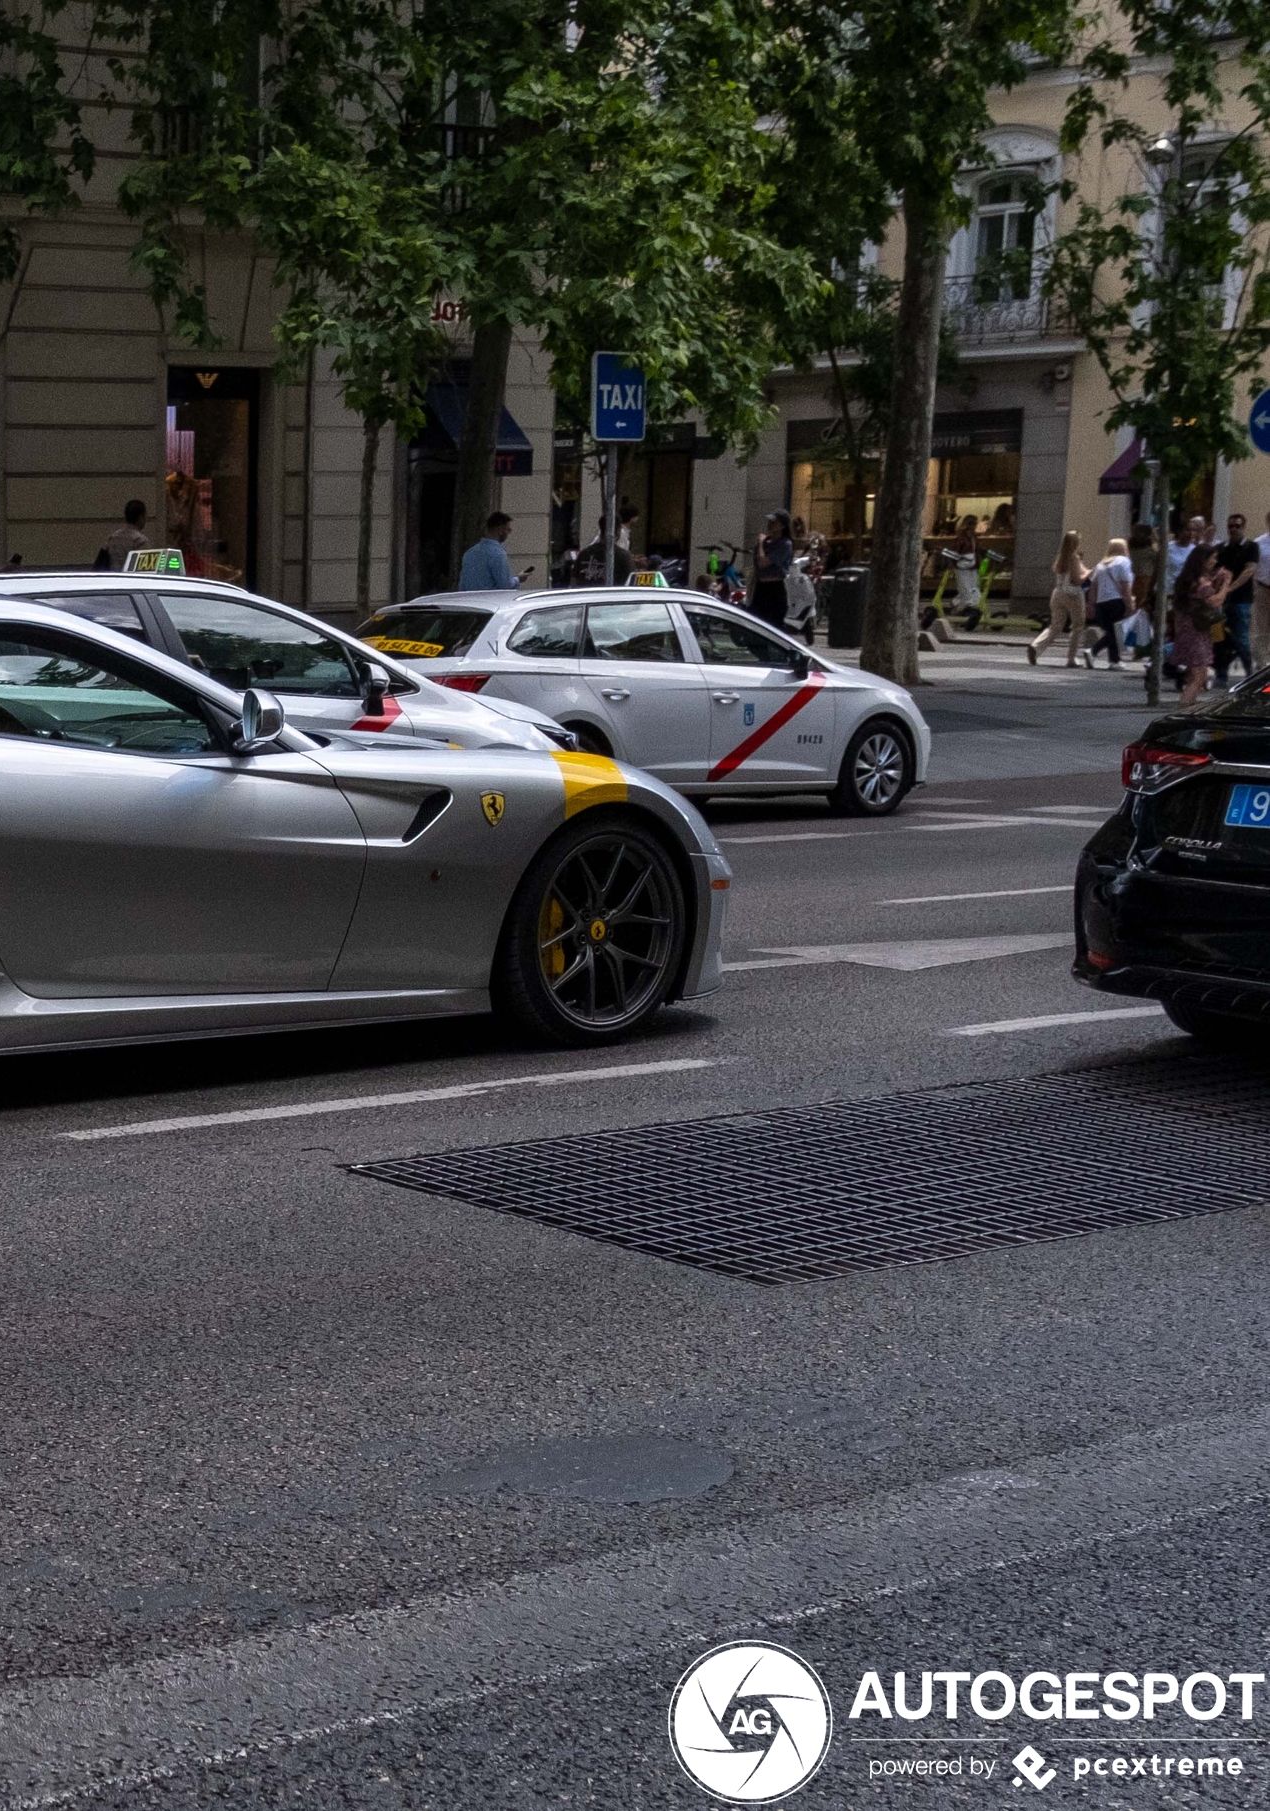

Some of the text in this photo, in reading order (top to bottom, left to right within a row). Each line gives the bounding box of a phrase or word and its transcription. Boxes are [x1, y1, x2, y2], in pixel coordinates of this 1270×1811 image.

[599, 384, 643, 410] TAXI
[425, 647, 439, 655] 00
[1231, 809, 1239, 818] E
